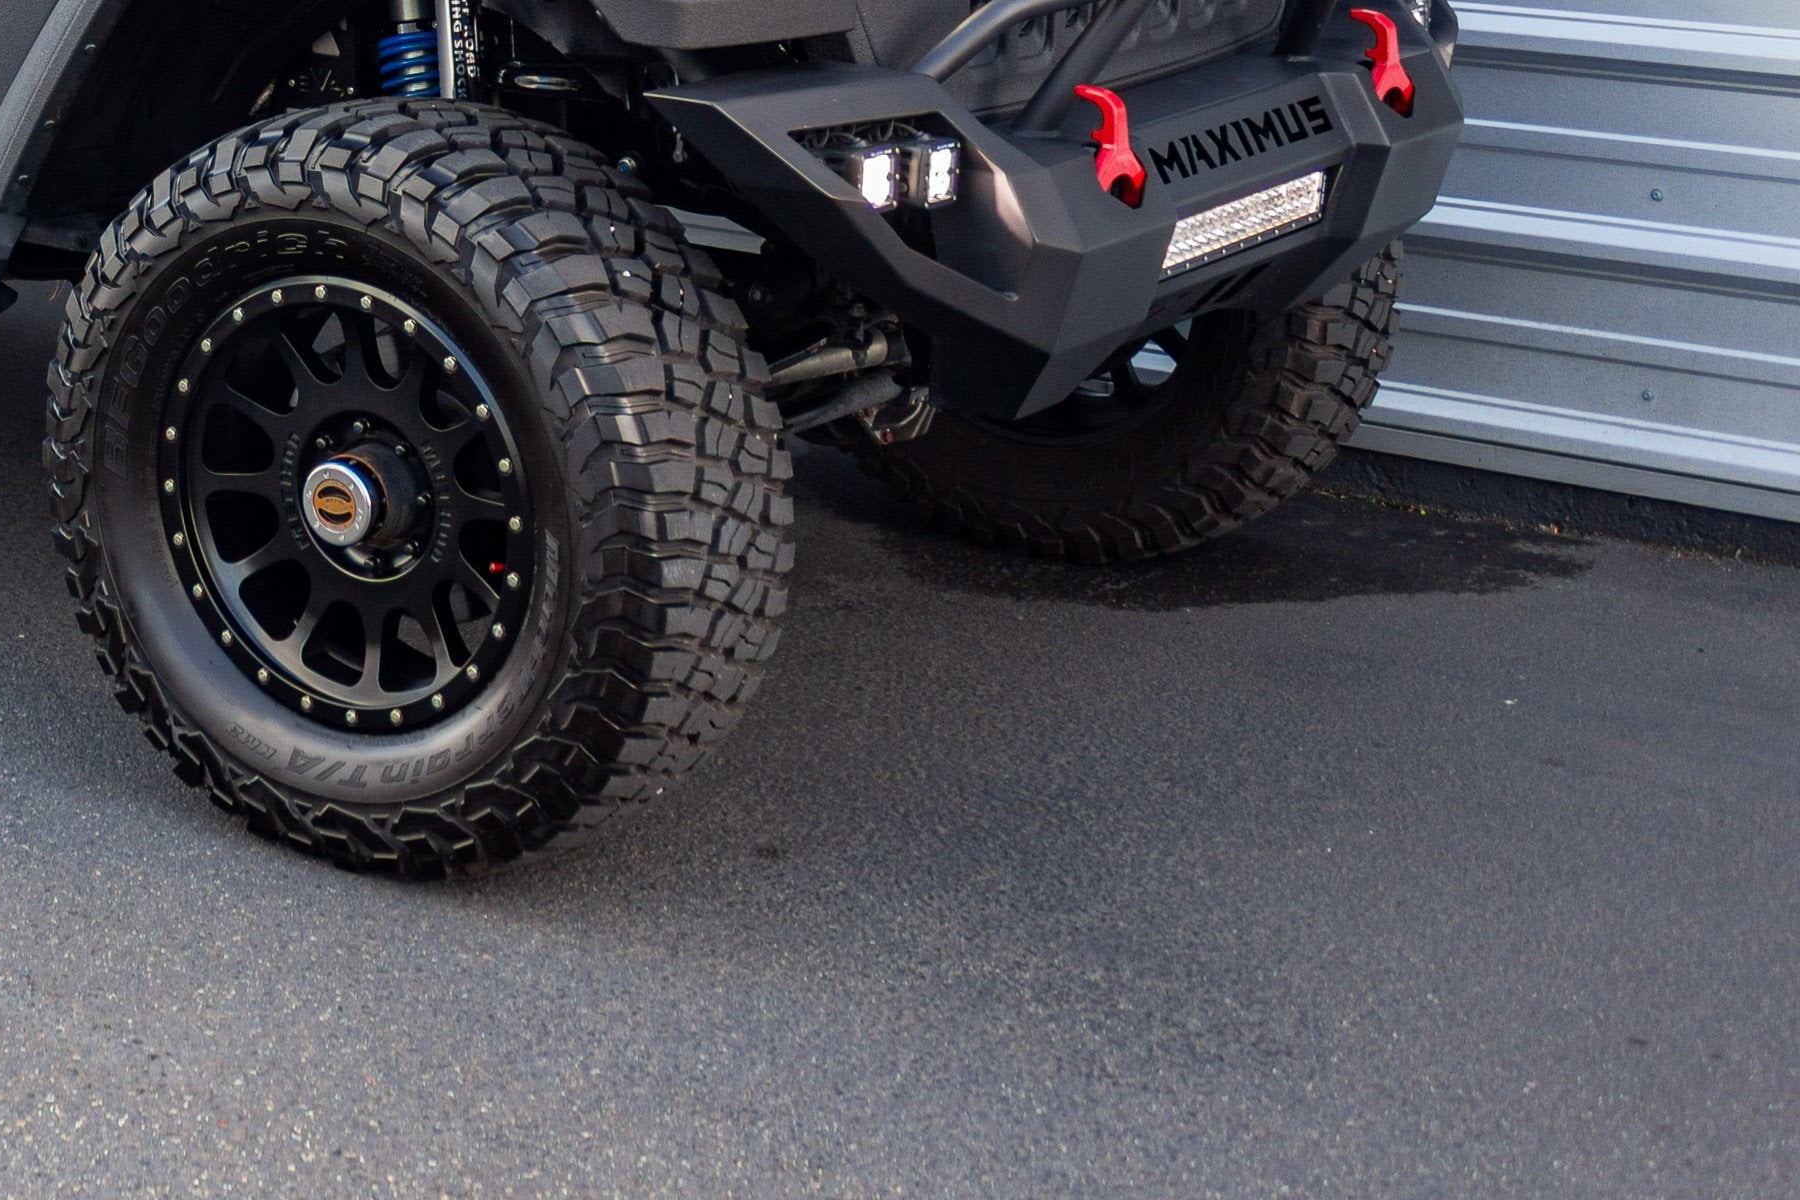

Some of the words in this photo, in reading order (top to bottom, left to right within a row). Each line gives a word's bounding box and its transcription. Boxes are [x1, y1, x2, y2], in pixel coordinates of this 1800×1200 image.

[1148, 96, 1333, 185] MAXIMUS
[103, 227, 351, 480] BFGoodrich
[285, 745, 369, 790] T/A
